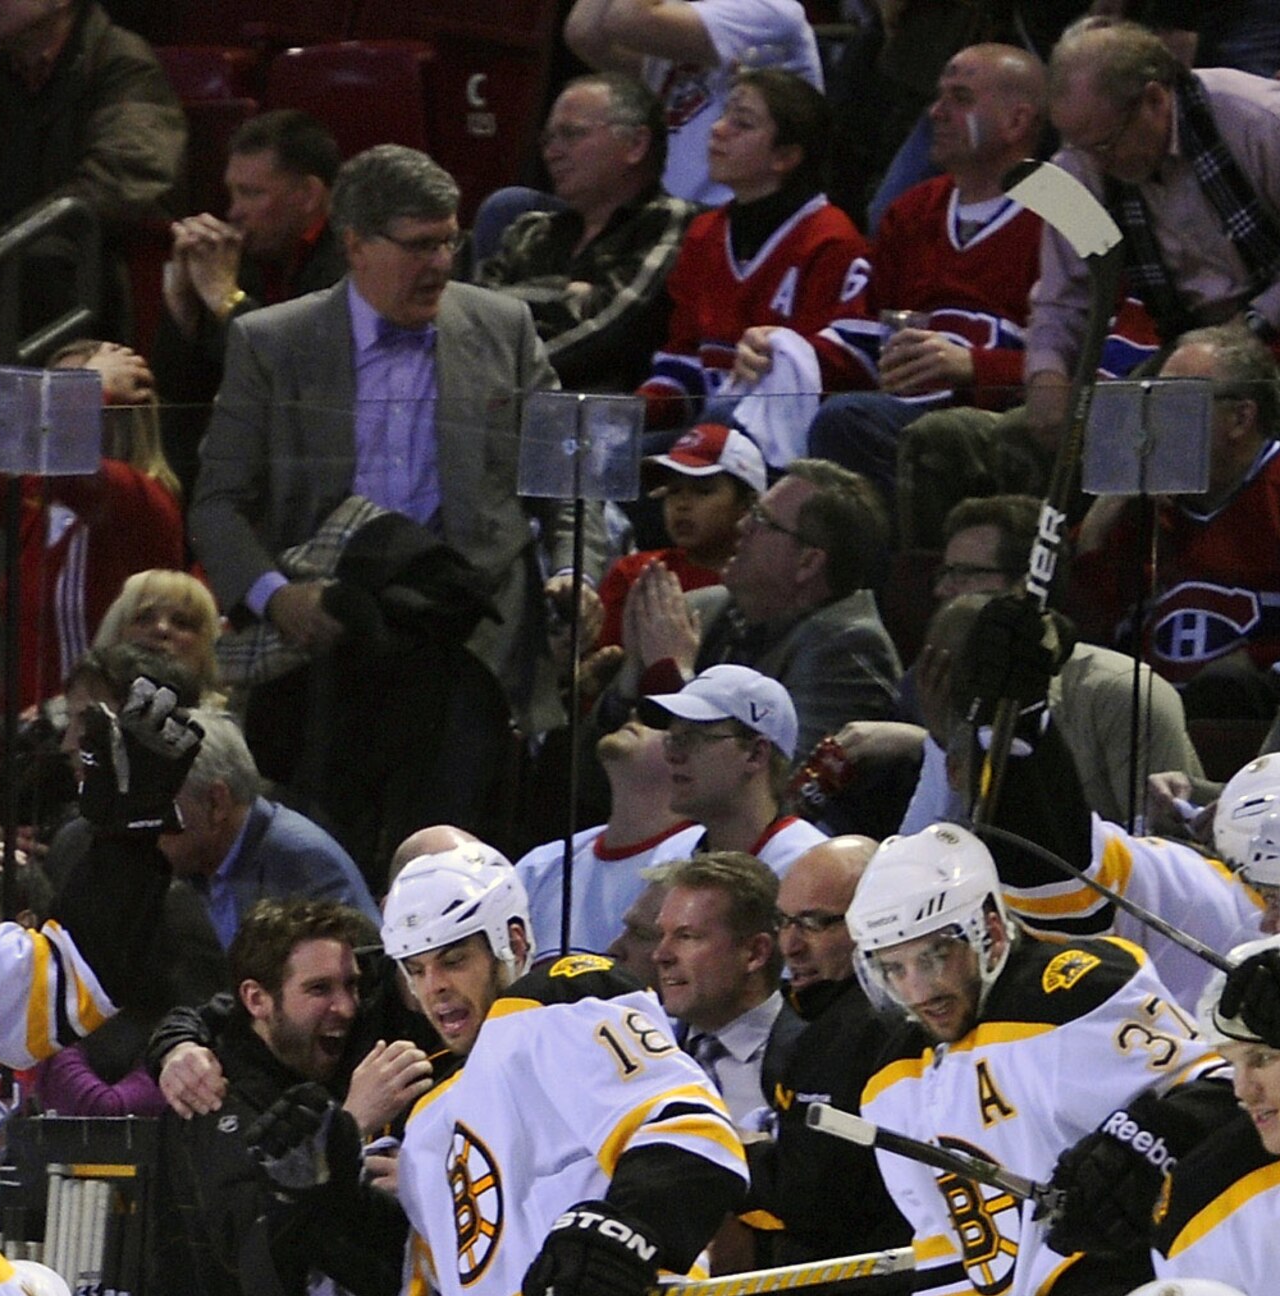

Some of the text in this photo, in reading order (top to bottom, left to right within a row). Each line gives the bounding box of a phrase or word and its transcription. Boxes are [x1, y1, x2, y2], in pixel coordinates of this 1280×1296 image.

[467, 73, 488, 106] C
[770, 266, 798, 317] A
[592, 1007, 680, 1081] 18
[1115, 992, 1202, 1069] 37
[974, 1056, 1017, 1129] A
[1102, 1111, 1178, 1178] Reebo
